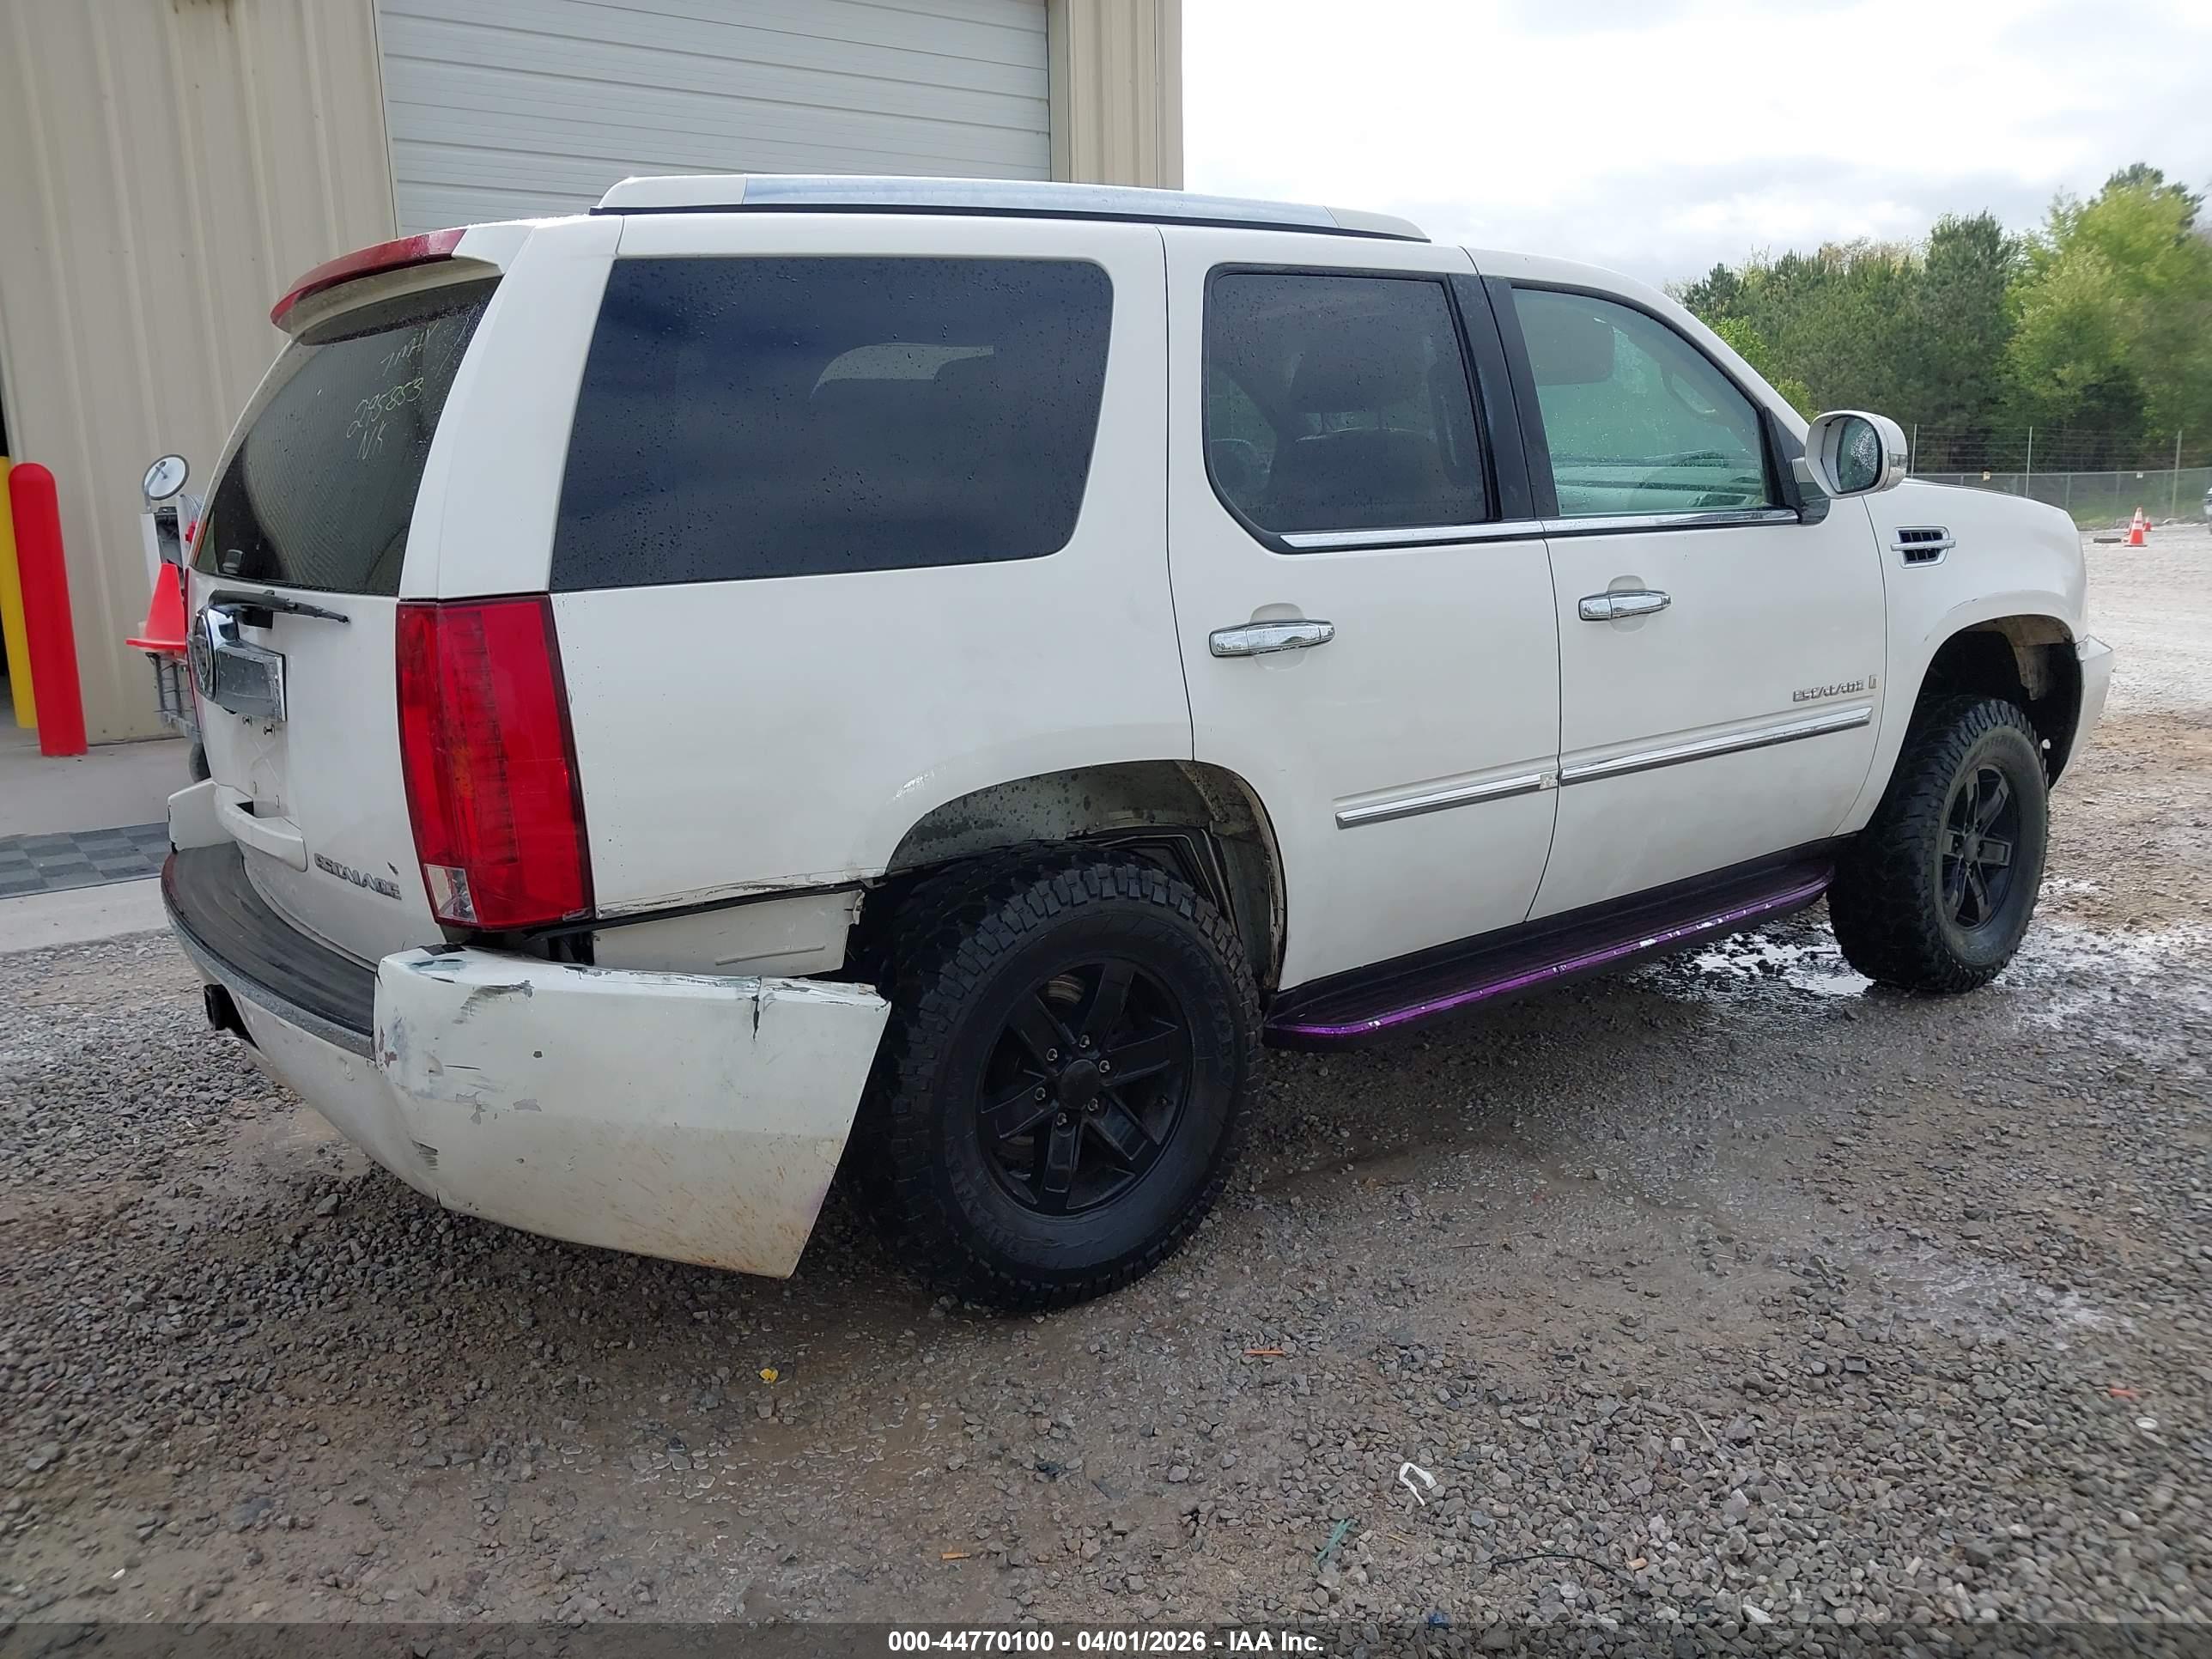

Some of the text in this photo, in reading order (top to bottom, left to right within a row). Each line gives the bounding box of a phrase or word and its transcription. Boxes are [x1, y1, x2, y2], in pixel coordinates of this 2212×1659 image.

[346, 377, 423, 439] 295853
[1792, 679, 1865, 702] ESCALADE
[313, 853, 402, 901] ESCALADE
